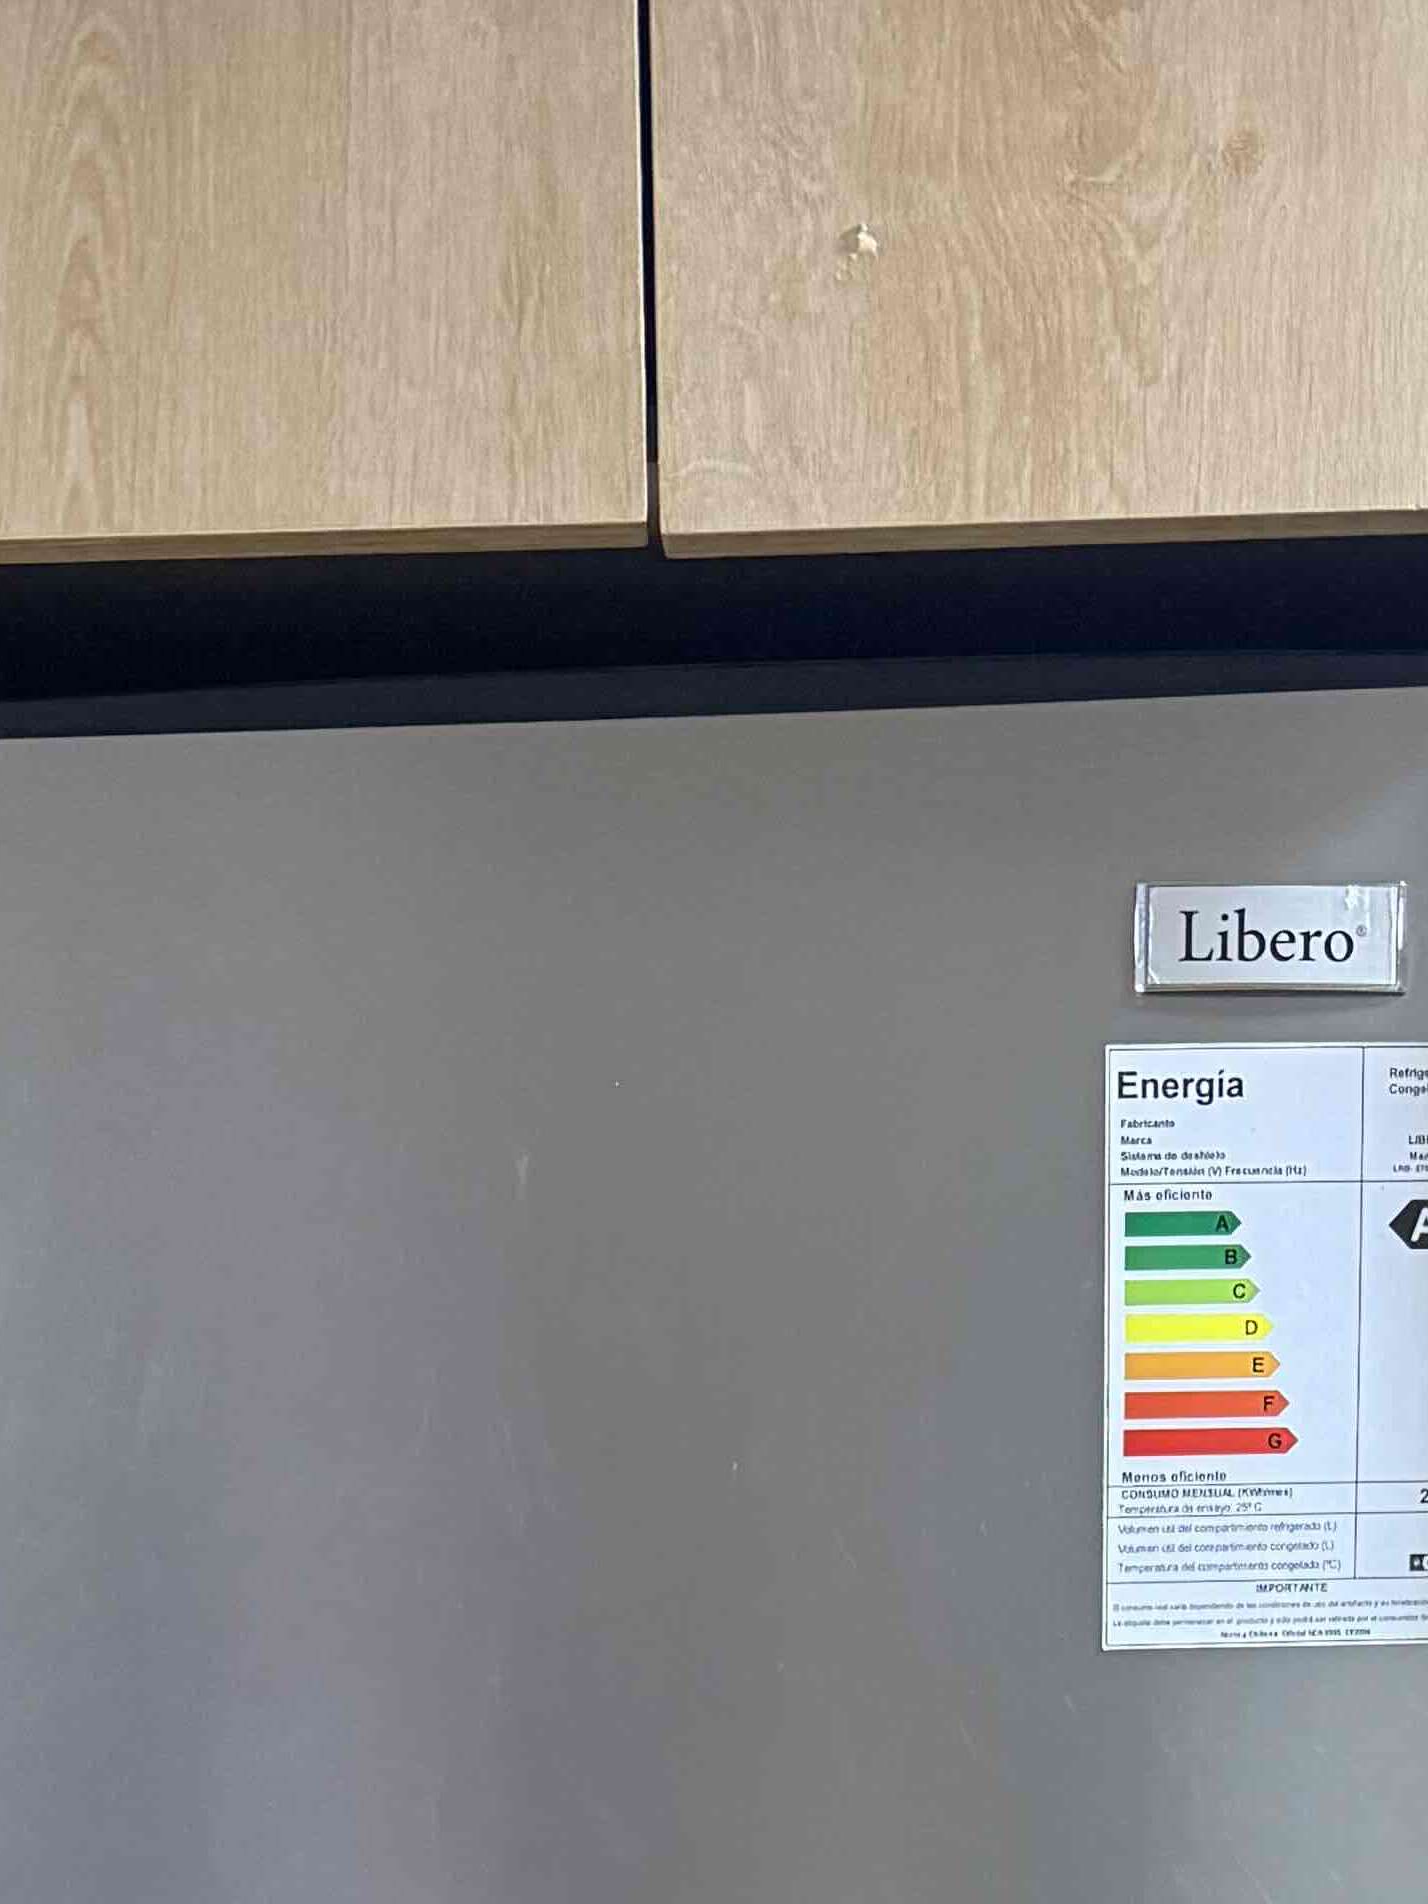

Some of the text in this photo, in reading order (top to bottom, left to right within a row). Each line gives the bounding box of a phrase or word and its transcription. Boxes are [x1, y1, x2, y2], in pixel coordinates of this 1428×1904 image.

[1117, 1069, 1244, 1106] Energía
[1120, 1119, 1175, 1128] Fabricante
[1120, 1136, 1152, 1145] Marca
[1120, 1151, 1161, 1161] Sistema
[1164, 1151, 1177, 1161] de
[1124, 1189, 1213, 1201] Más eficiente
[1215, 1215, 1230, 1233] A
[1225, 1249, 1238, 1265] B
[1233, 1283, 1246, 1299] C
[1245, 1319, 1258, 1335] D
[1252, 1357, 1264, 1373] E
[1263, 1396, 1275, 1411] F
[1268, 1433, 1282, 1449] G
[1122, 1471, 1226, 1483] Menos eficiente
[1121, 1488, 1179, 1500] CONSUMO
[1182, 1488, 1235, 1499] MENSUAL
[1118, 1503, 1179, 1514] Temperatura
[1271, 1521, 1321, 1533] refrigerado
[1256, 1583, 1328, 1593] IMPORTANTE
